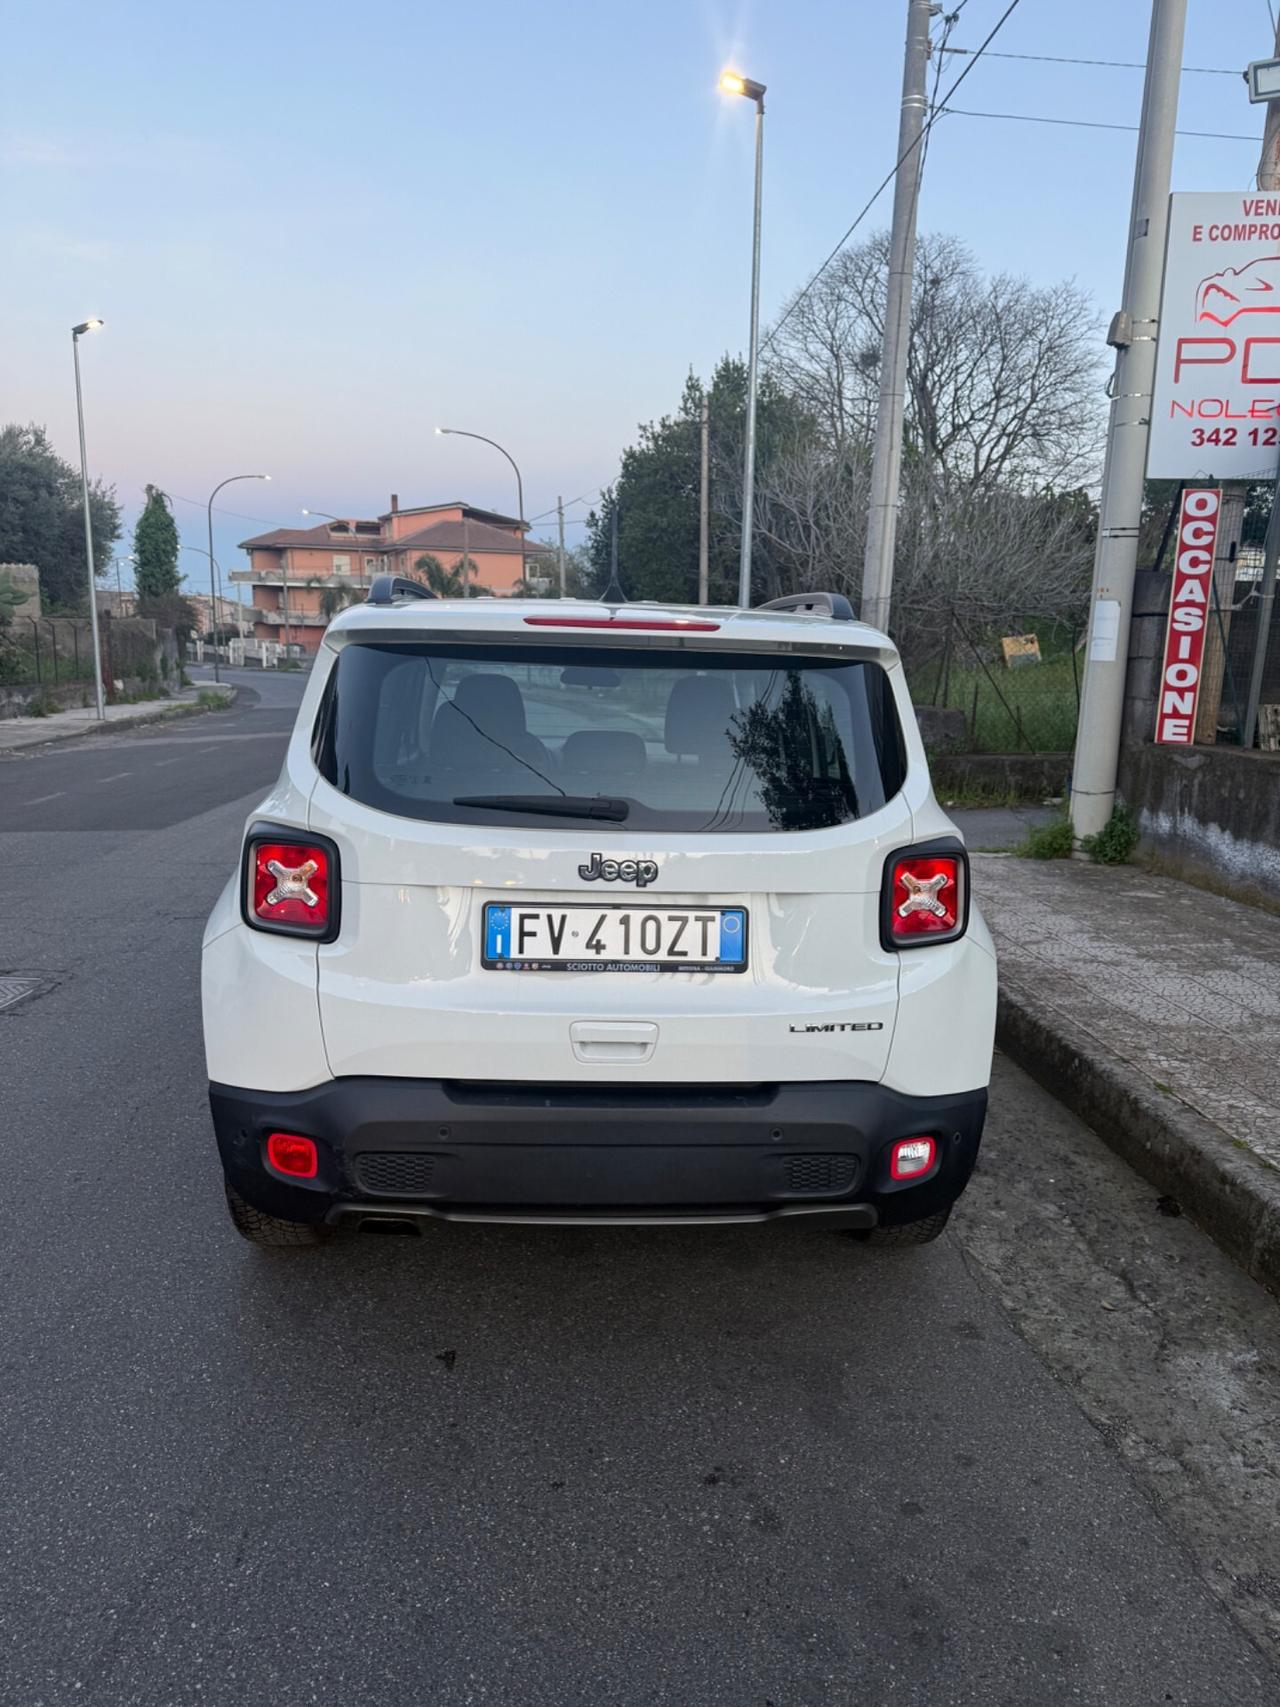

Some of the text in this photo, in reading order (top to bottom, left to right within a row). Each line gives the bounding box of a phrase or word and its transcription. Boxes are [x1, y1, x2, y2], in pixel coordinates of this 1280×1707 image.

[1243, 199, 1280, 216] VEN
[1192, 225, 1203, 242] E
[1170, 399, 1280, 419] NOLE
[1190, 427, 1280, 447] 342 12
[1161, 491, 1219, 743] OCCASIONE
[578, 852, 658, 888] Jeep
[518, 913, 568, 955] FV
[566, 962, 661, 972] SCIOTTO AUTOMOBILI
[788, 1021, 884, 1033] LIMITED
